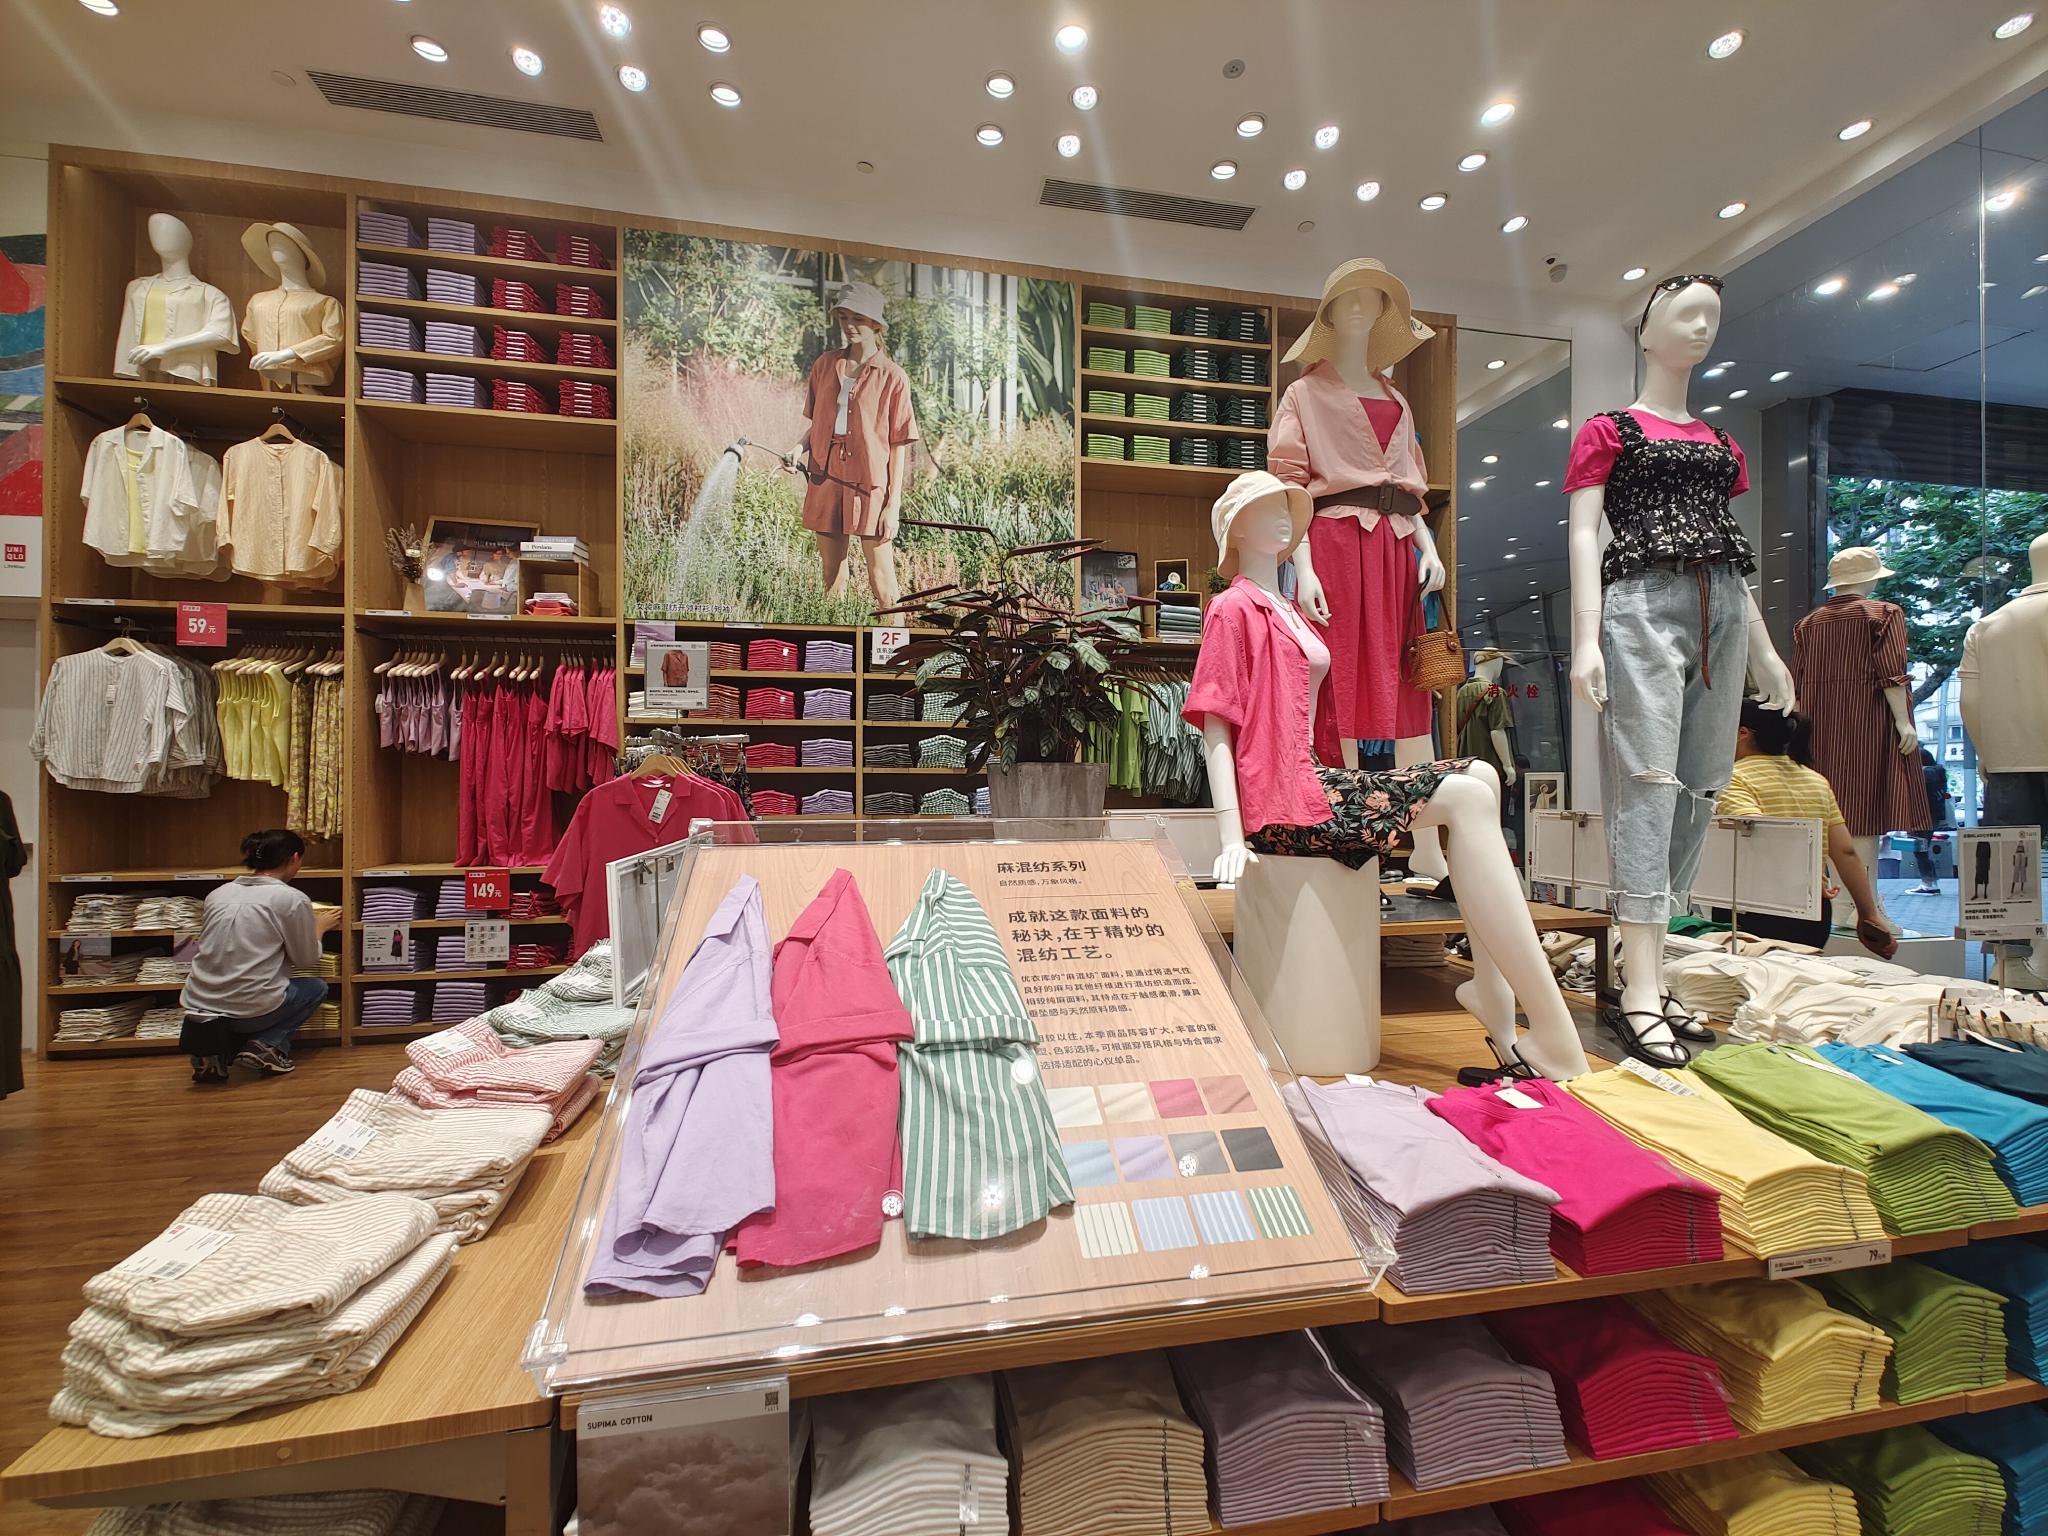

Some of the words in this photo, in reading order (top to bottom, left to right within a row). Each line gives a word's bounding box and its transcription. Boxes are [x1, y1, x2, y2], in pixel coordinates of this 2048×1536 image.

[881, 631, 901, 645] 2F
[1488, 683, 1539, 698] 消火栓
[997, 860, 1087, 874] 麻混纺系列
[1008, 906, 1149, 923] 成就这款面料的
[1011, 923, 1165, 942] 秘诀，在于精妙的
[1016, 945, 1112, 963] 混纺工艺。
[587, 1419, 617, 1430] SUPIMA
[620, 1414, 653, 1426] COTTON
